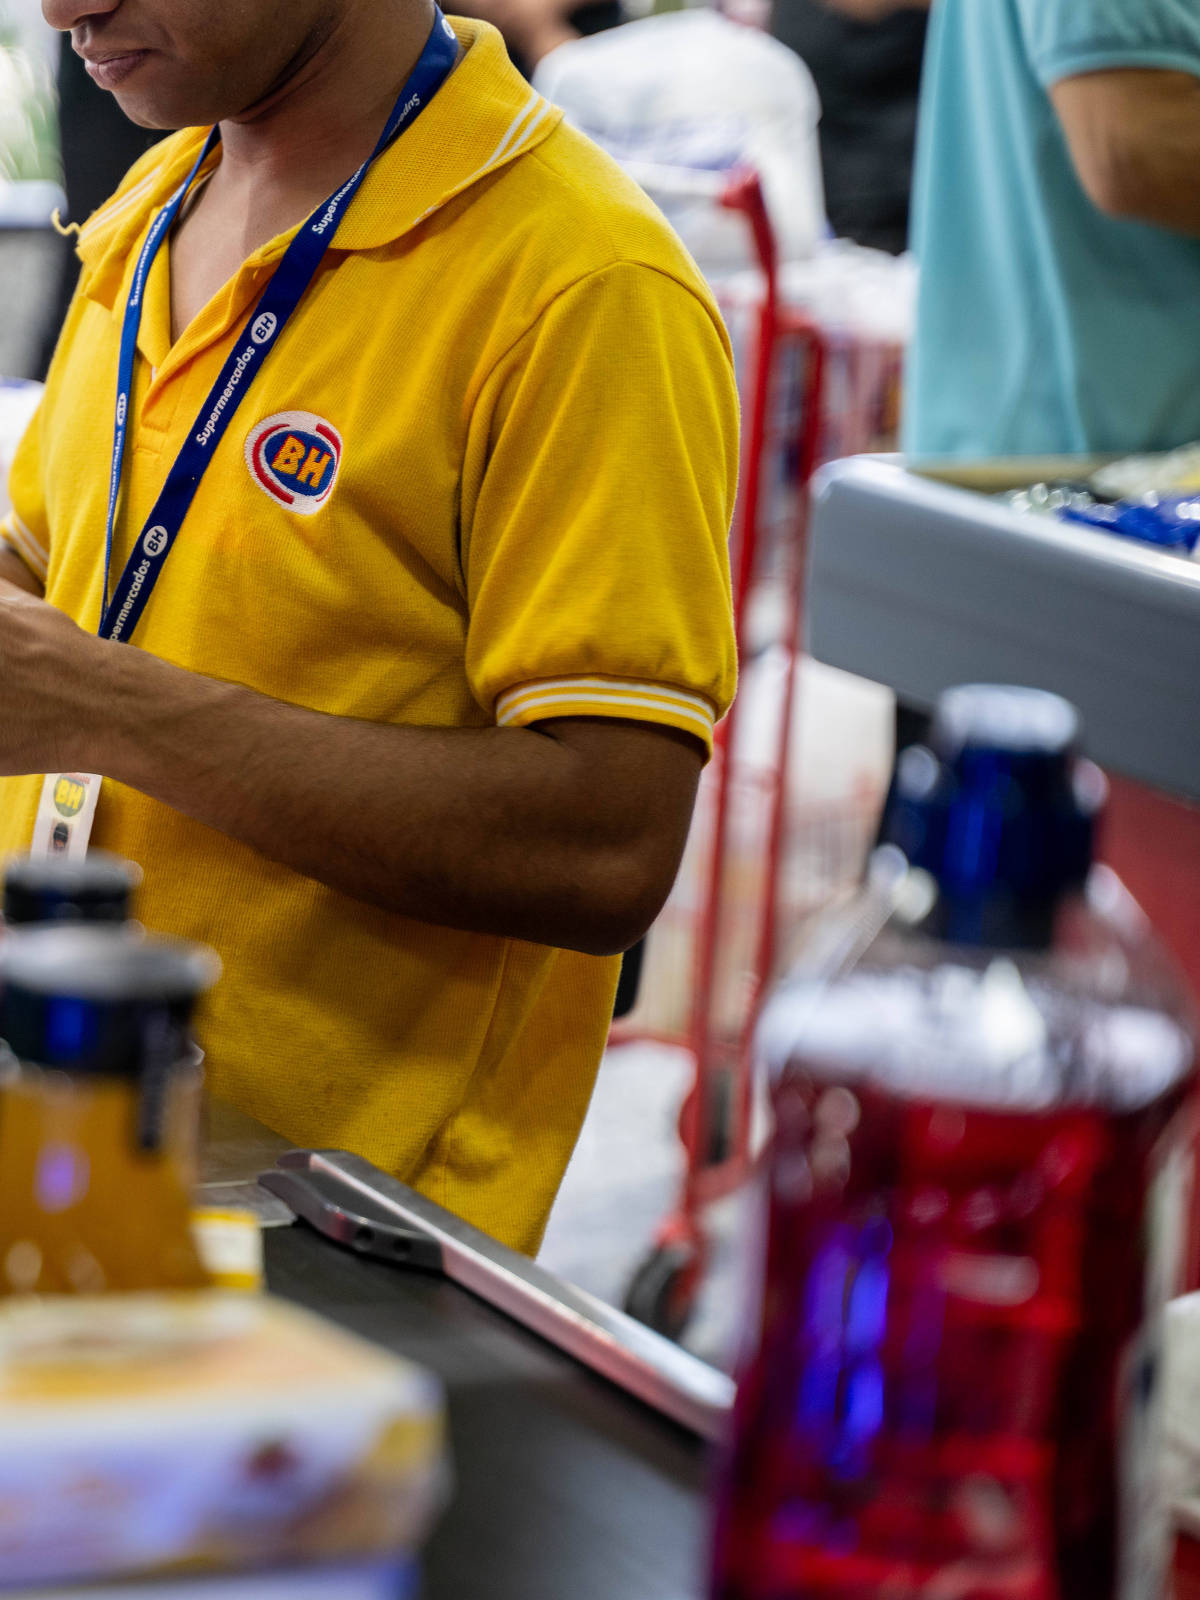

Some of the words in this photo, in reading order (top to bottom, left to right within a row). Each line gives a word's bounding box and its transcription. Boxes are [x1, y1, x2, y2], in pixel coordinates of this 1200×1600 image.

[195, 345, 256, 447] Supermercados
[254, 315, 275, 341] BH
[271, 433, 332, 489] BH
[110, 558, 151, 641] permercados
[146, 528, 165, 553] BH
[55, 778, 84, 809] BH
